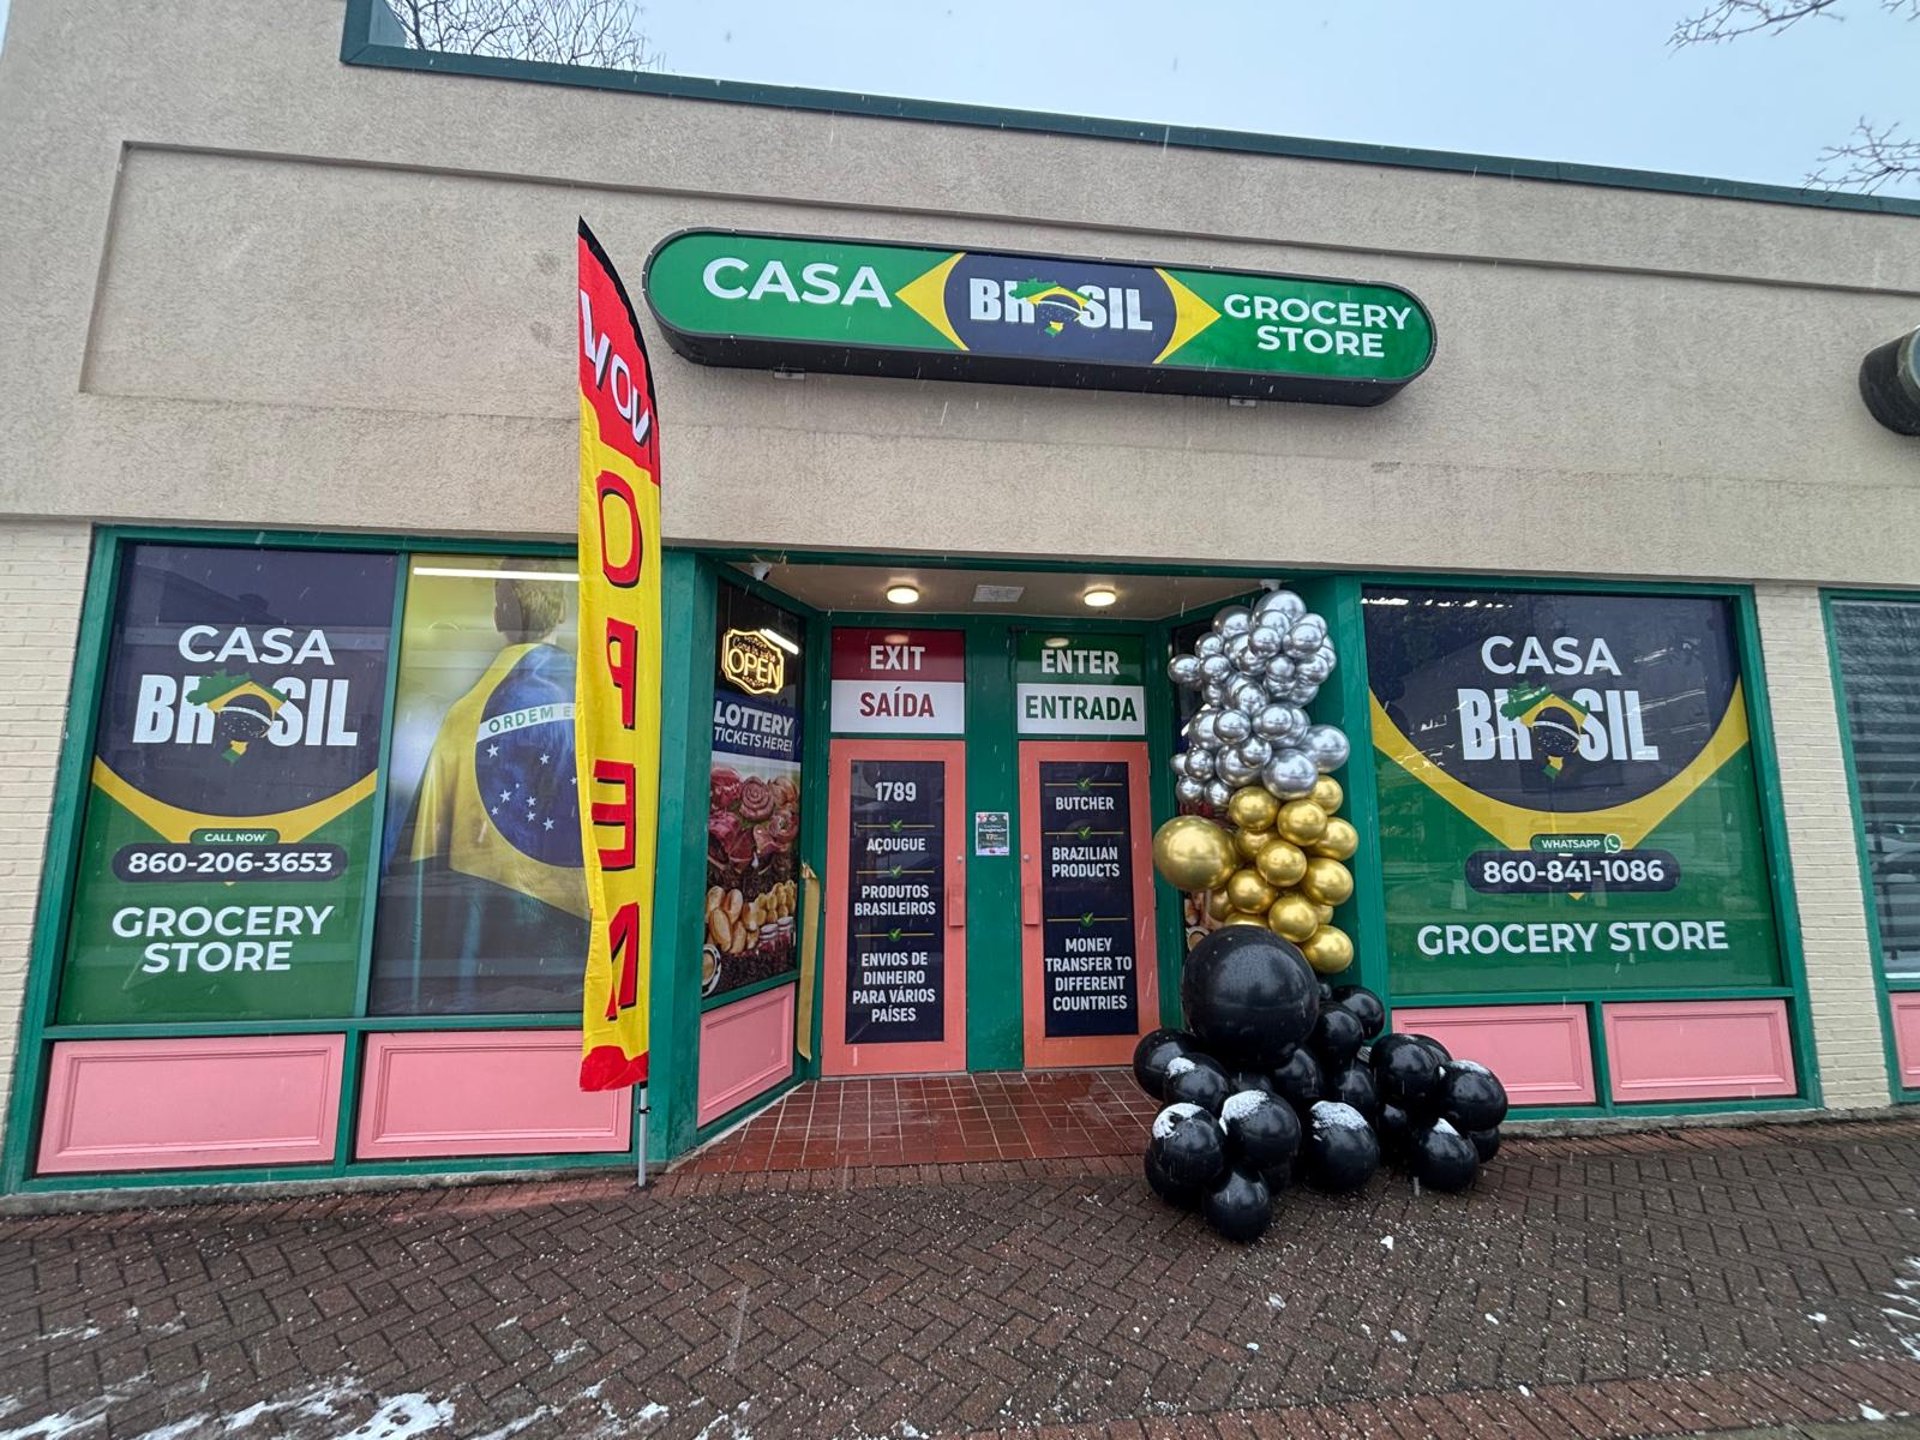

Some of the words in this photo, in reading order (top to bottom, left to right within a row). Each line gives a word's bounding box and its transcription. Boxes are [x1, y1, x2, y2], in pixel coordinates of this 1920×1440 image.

[702, 256, 892, 308] CASA
[969, 277, 1154, 332] BRSIL
[1223, 293, 1411, 332] GROCERY
[1257, 324, 1386, 358] STORE
[178, 625, 335, 666] CASA
[870, 645, 925, 671] EXIT
[1481, 635, 1623, 676] CASA
[728, 648, 781, 687] OPEN
[1041, 649, 1120, 675] ENTER
[132, 673, 359, 747] BRSIL
[860, 686, 935, 717] SAÍDA
[1025, 695, 1137, 722] ENTRADA
[488, 706, 554, 733] ORDEM
[714, 700, 794, 737] LOTTERY
[1456, 687, 1660, 762] BRSIL
[714, 726, 761, 748] TICKETS
[762, 735, 792, 752] HERE!
[874, 781, 917, 802] 1789
[1055, 796, 1114, 811] BUTCHER
[204, 833, 234, 843] CALL
[236, 833, 267, 843] NOW
[866, 837, 926, 855] AÇOUGUE
[1541, 839, 1601, 850] WHATSAPP
[128, 852, 333, 874] 860-206-3653
[1052, 846, 1118, 861] BRAZILIAN
[1052, 863, 1120, 878] PRODUCTS
[1483, 858, 1665, 885] 860-841-1086
[861, 885, 930, 900] PRODUTOS
[112, 905, 334, 938] GROCERY
[854, 901, 936, 916] BRASILEIROS
[1065, 937, 1113, 953] MONEY
[1417, 922, 1598, 956] GROCERY
[1608, 920, 1729, 952] STORE
[142, 941, 292, 974] STORE
[861, 952, 909, 967] ENVIOS
[911, 952, 928, 966] DE
[1045, 956, 1111, 972] TRANSFER
[1113, 956, 1132, 971] TO
[863, 970, 926, 986] DINHEIRO
[1055, 975, 1126, 991] DIFFERENT
[852, 989, 887, 1005] PARA
[888, 985, 936, 1004] VÁRIOS
[1052, 995, 1128, 1012] COUNTRIES
[871, 1005, 917, 1023] PAÍSES
